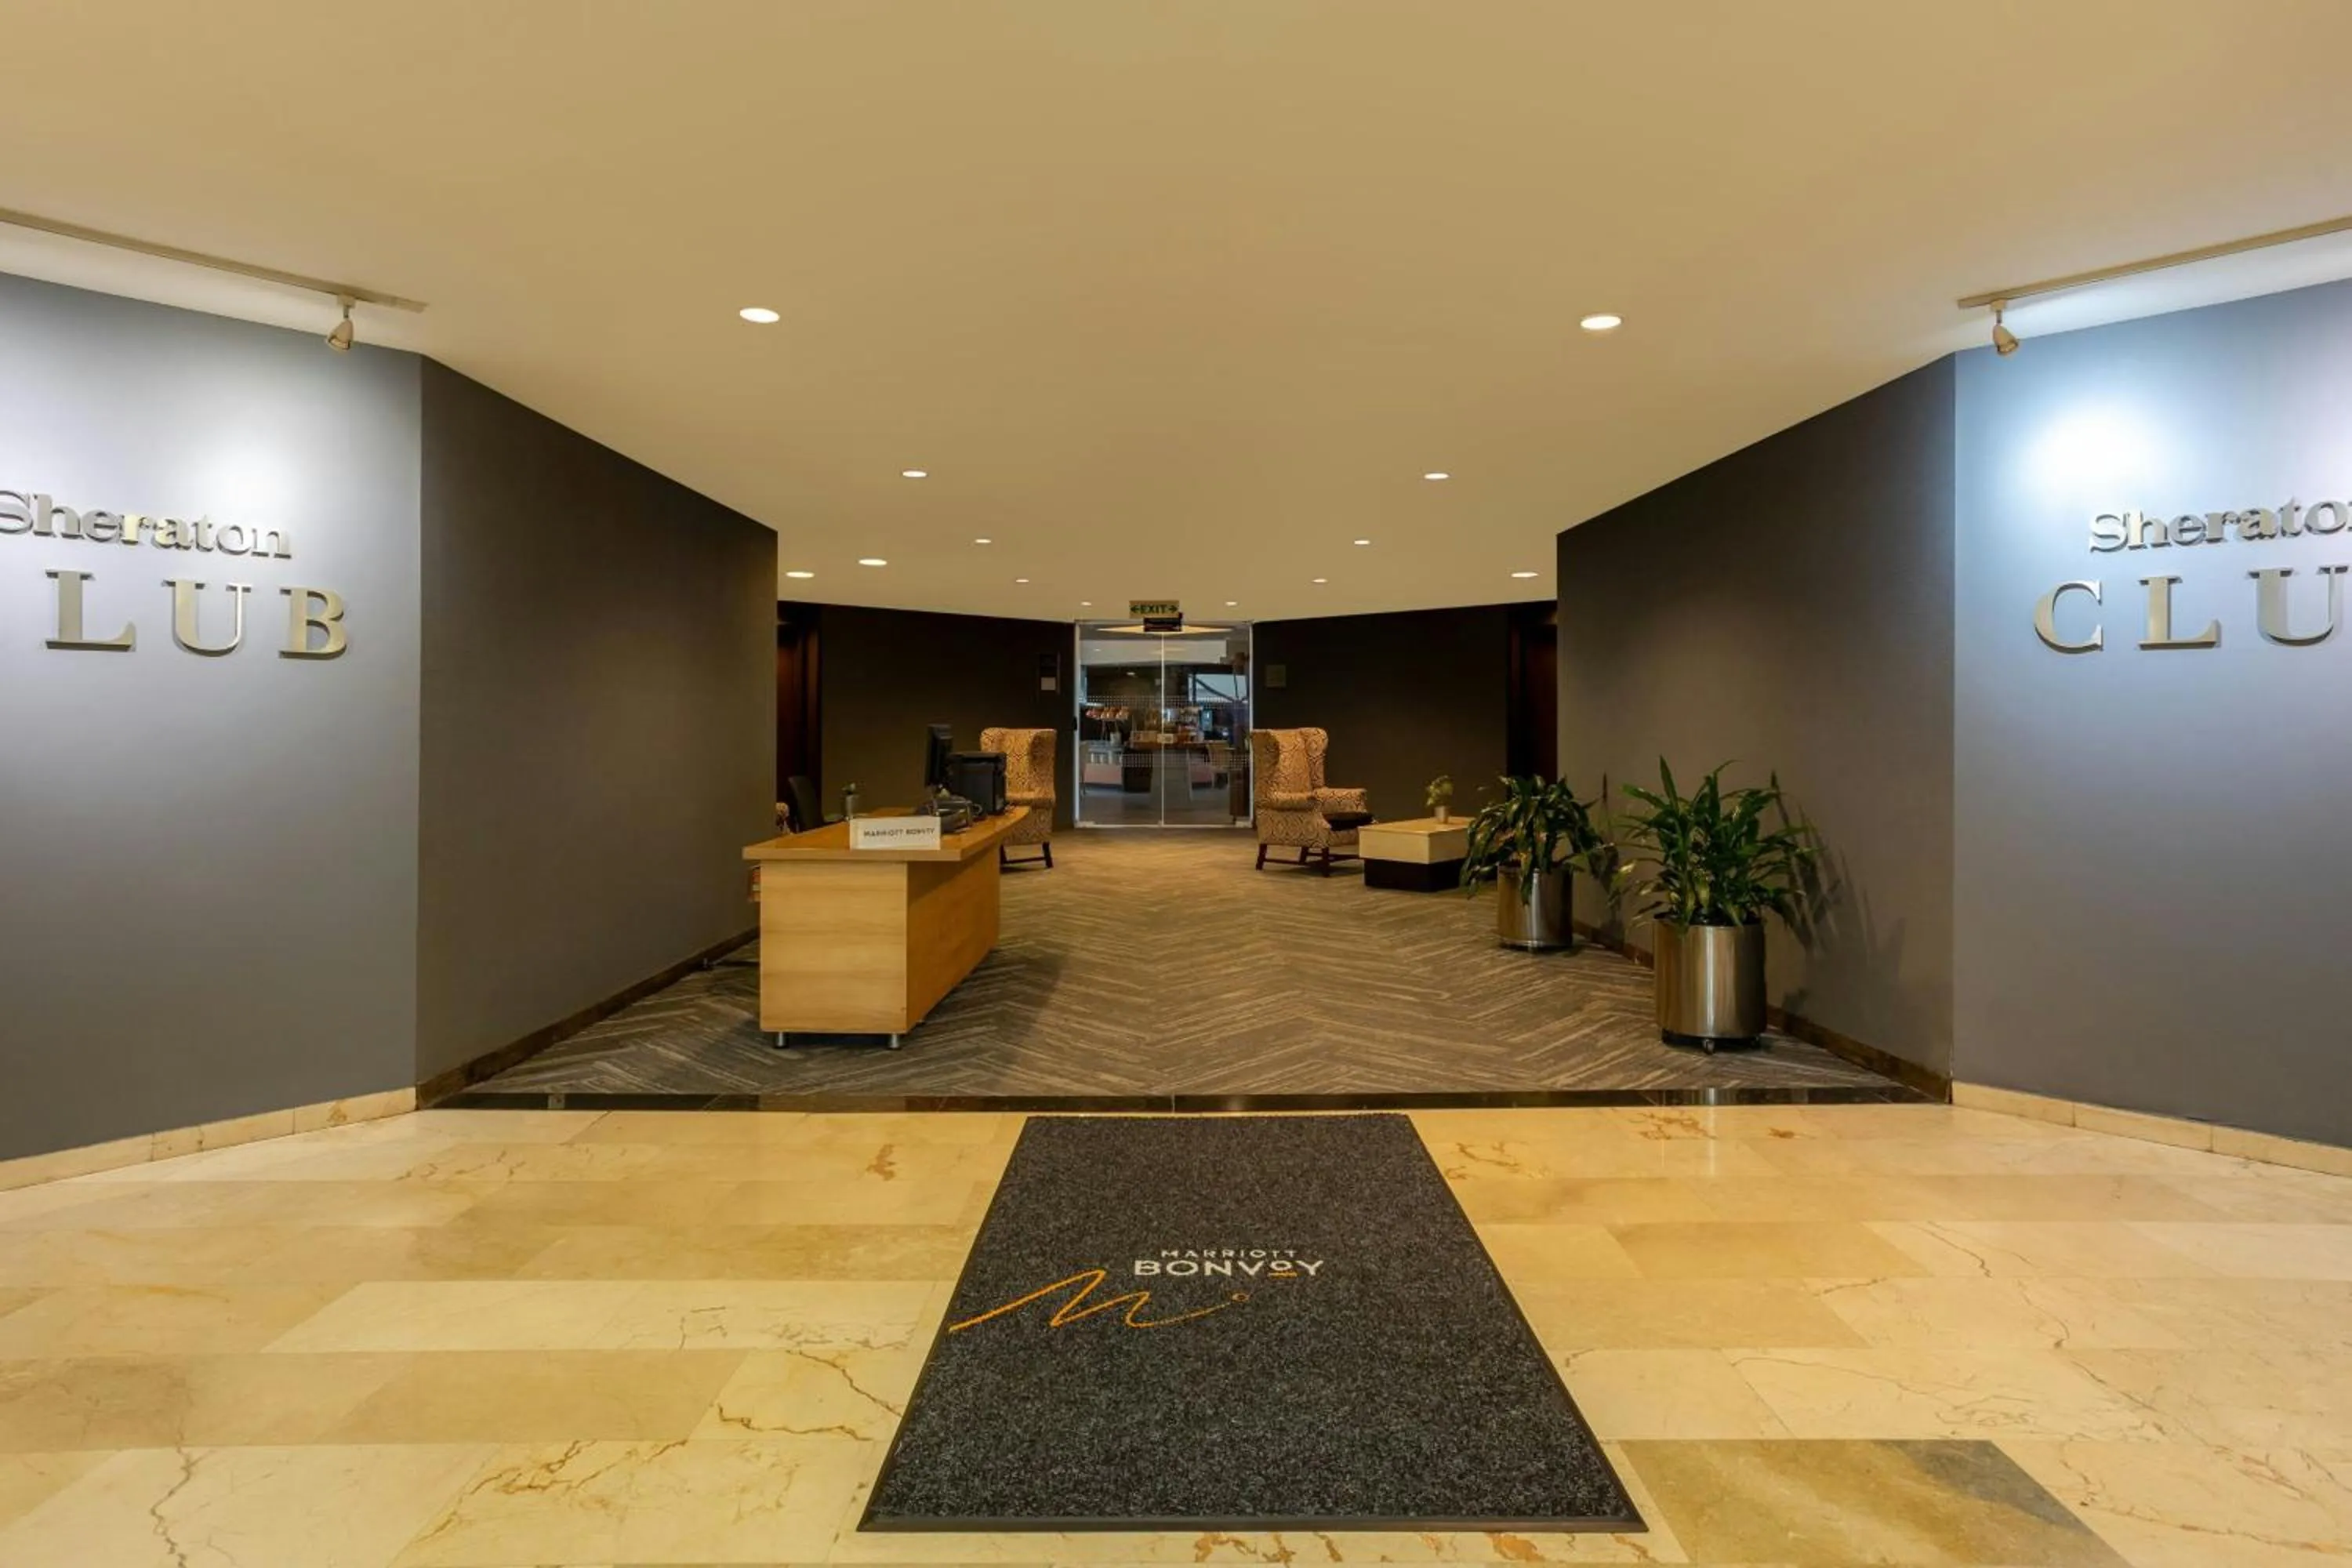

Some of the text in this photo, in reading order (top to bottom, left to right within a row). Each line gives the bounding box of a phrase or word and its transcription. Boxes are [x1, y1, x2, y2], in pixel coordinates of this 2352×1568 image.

[0, 489, 292, 560] Sheraton
[2089, 494, 2352, 554] Sherato
[1140, 604, 1167, 615] EXIT
[1161, 1249, 1297, 1258] MARRIOTT
[1134, 1260, 1323, 1277] BONVOY
